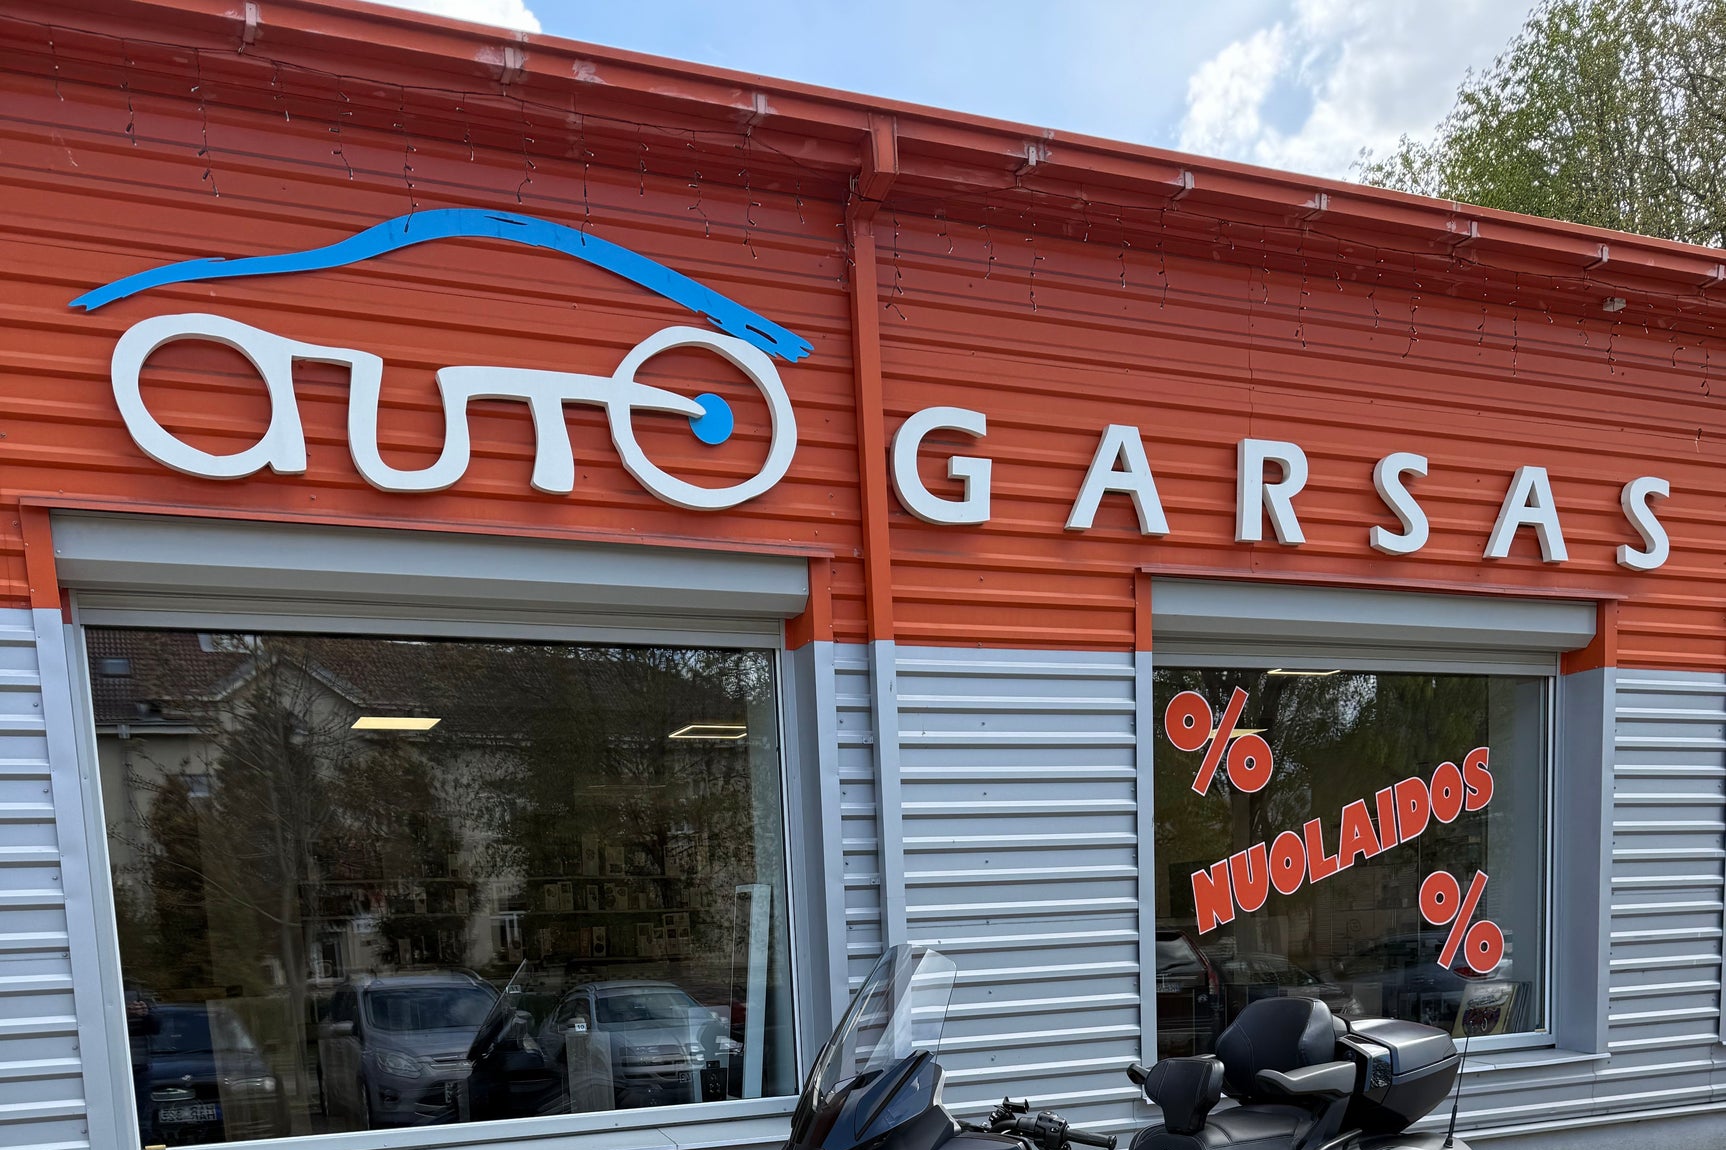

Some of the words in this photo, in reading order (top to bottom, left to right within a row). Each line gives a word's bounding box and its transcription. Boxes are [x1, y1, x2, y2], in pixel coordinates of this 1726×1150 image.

[891, 406, 1670, 571] GARSAS
[1164, 686, 1273, 796] %
[1190, 746, 1494, 935] NUOLAIDOS
[1419, 869, 1505, 975] %
